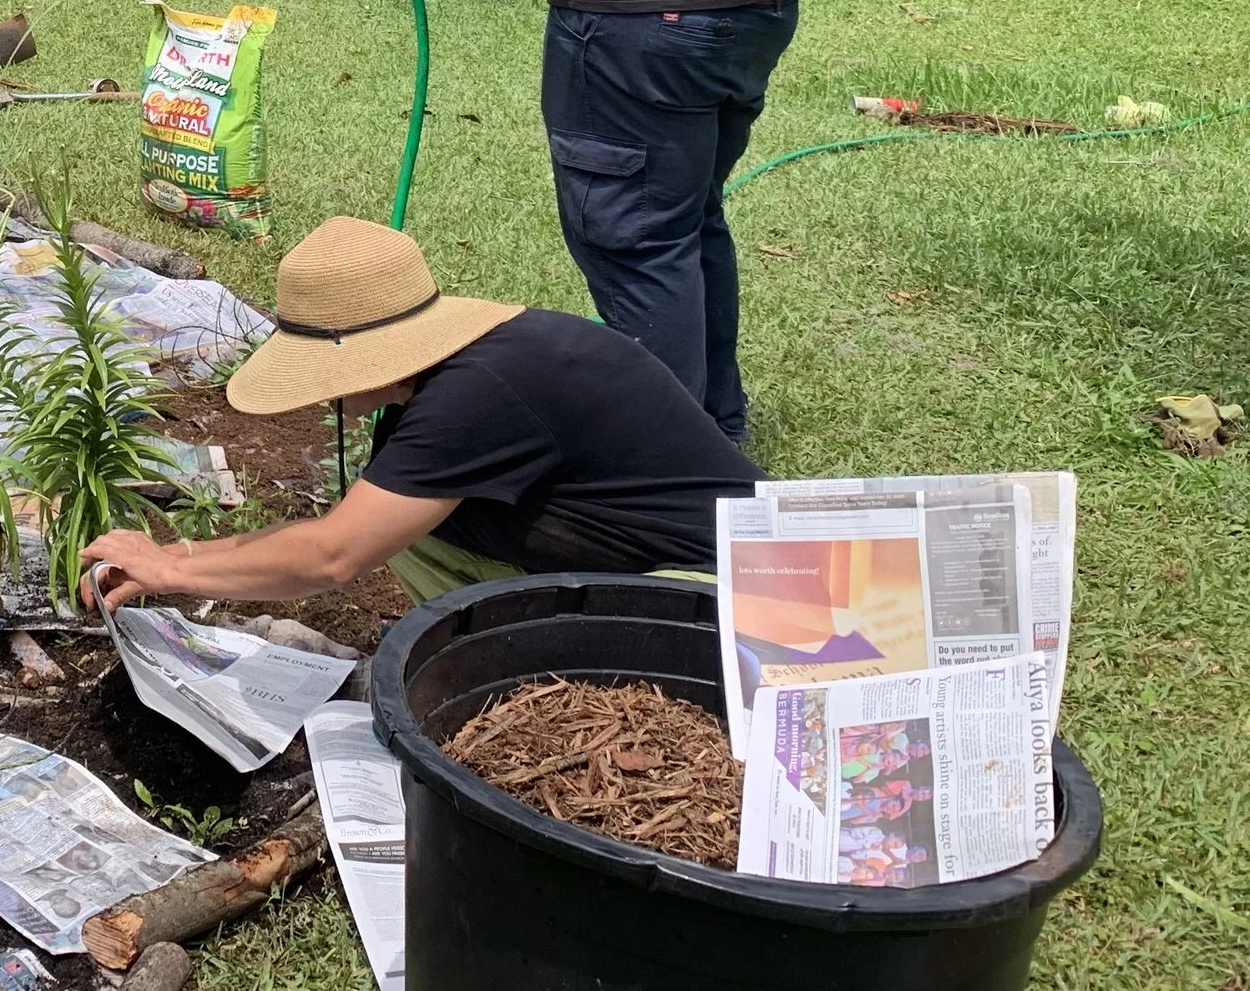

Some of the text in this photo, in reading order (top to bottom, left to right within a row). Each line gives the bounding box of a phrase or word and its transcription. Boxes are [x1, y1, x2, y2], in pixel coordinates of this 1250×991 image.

[149, 63, 231, 97] MotLand
[183, 135, 208, 147] BLEND
[152, 146, 219, 174] PURPOSE
[141, 160, 220, 193] ANTING MIX
[738, 565, 820, 576] lots worth celebrating!
[1034, 622, 1059, 634] CRIME
[266, 653, 330, 672] EMPLOYMENT
[938, 643, 1014, 655] Do you need to put
[939, 657, 952, 665] the
[954, 656, 975, 665] word
[1024, 661, 1049, 712] Aliya
[790, 692, 802, 721] Good
[776, 693, 787, 754] BERMUDA
[1030, 719, 1052, 775] looks
[932, 675, 958, 876] Young artists shine on stage for
[1034, 781, 1054, 832] back
